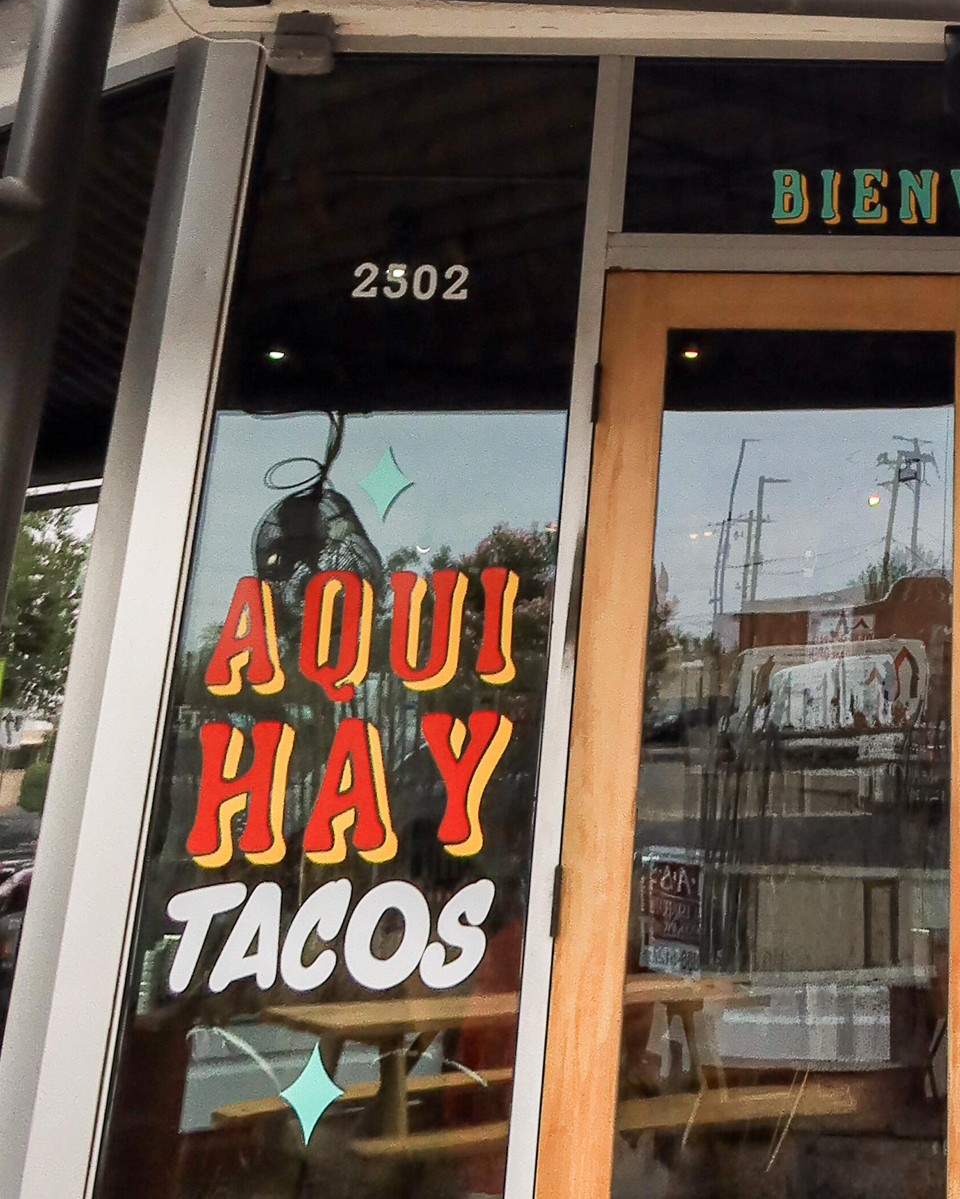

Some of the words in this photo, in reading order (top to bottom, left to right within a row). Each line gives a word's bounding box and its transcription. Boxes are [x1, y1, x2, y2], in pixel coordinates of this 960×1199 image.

[352, 264, 469, 301] 2502
[206, 569, 518, 700] AQUI
[187, 711, 513, 868] HAY
[167, 879, 496, 994] TACOS
